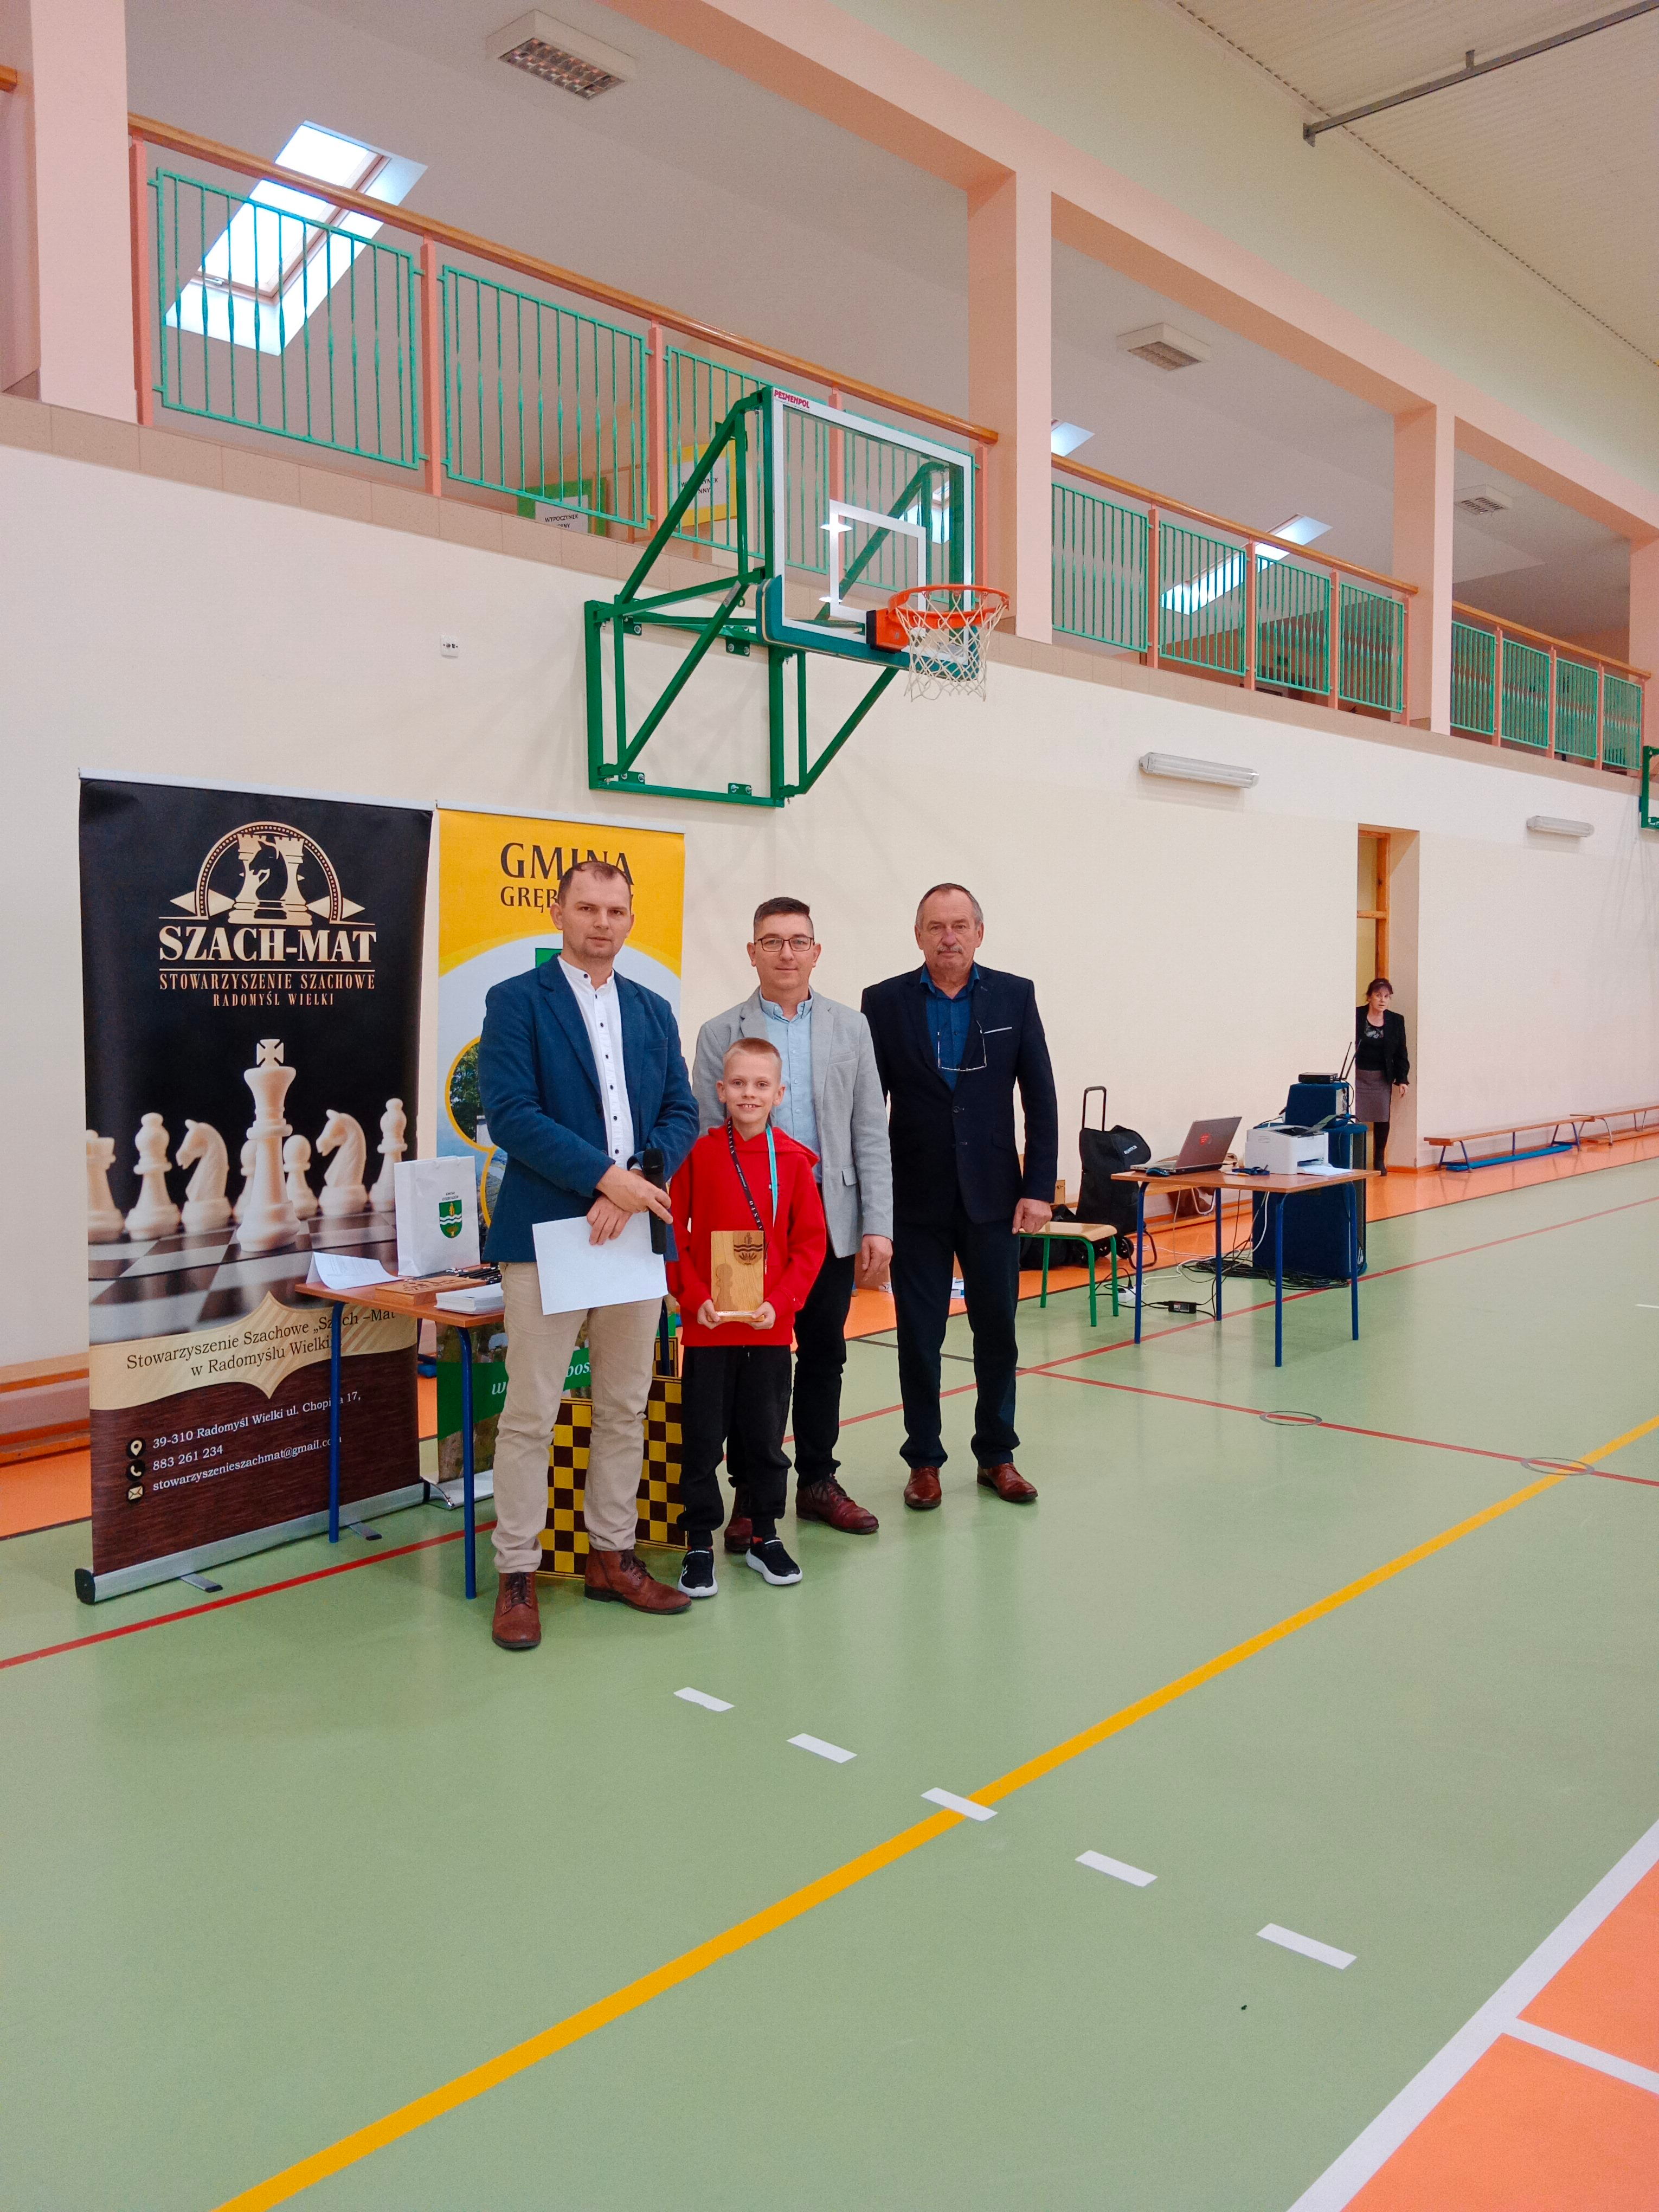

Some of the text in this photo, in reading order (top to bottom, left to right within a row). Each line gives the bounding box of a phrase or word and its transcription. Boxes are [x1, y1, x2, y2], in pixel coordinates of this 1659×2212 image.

[159, 925, 377, 962] SZACH-MAT
[160, 973, 375, 989] STOWARZYSZENIE SZACHOWE
[214, 991, 334, 1007] RADOMYŚL WIELKI
[126, 1335, 239, 1370] Stowarzyszenie
[243, 1323, 309, 1346] Szachowe
[313, 1312, 358, 1334] „Szch
[191, 1335, 342, 1377] w Radomyślu Wielki
[152, 1391, 361, 1449] 39-310 Radomyśl Wielki ul. Chopia 17,
[152, 1444, 223, 1471] 883 261 234
[152, 1436, 342, 1491] stowarzyszenieszachmat@gmail.co
